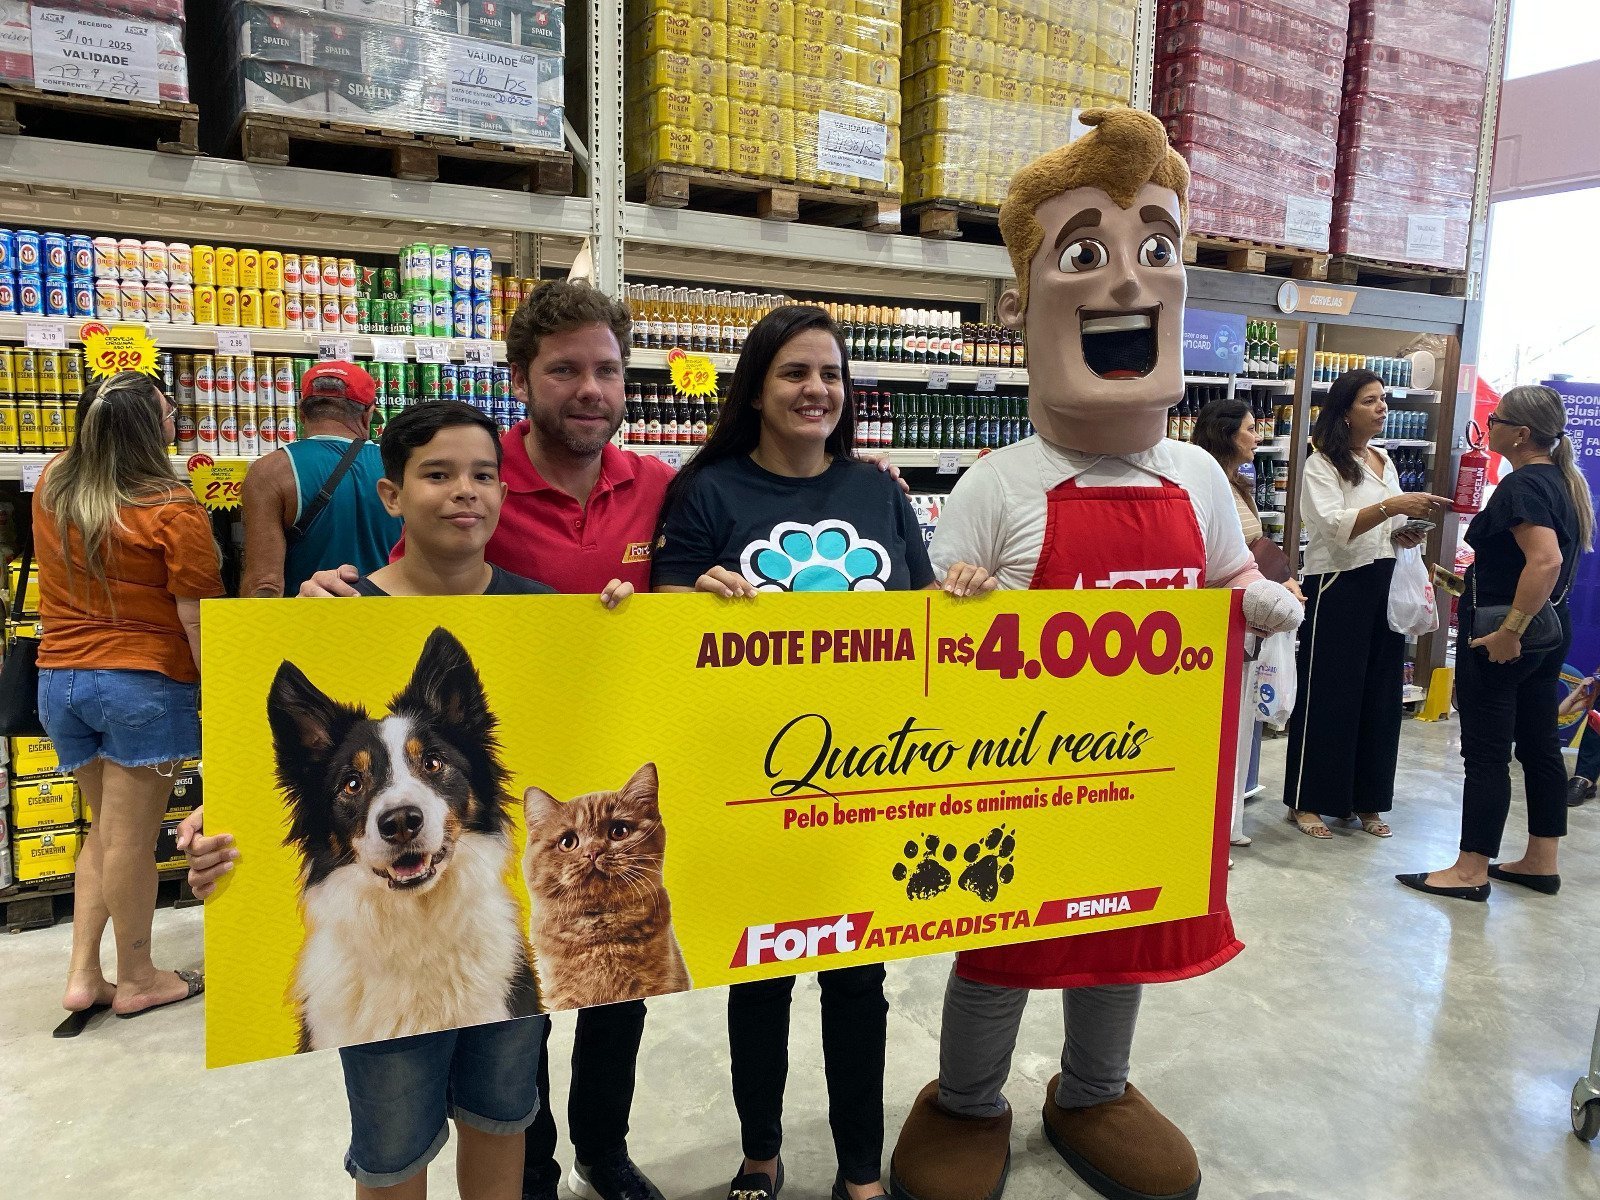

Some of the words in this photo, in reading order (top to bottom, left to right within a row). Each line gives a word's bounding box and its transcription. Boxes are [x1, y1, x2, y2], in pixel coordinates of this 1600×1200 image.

[737, 3, 756, 13] PILSEN
[804, 7, 825, 19] SKOL
[1205, 0, 1230, 15] BRAHMA
[77, 19, 113, 29] RECEBIDO
[479, 17, 502, 28] SPATEN
[667, 15, 690, 28] SKOL
[804, 17, 822, 26] PILSEN
[531, 27, 553, 38] SPATEN
[667, 27, 687, 36] PILSEN
[737, 29, 759, 41] SKOL
[108, 39, 133, 51] 2025
[263, 35, 290, 47] SPATEN
[737, 39, 756, 48] PILSEN
[325, 45, 350, 56] SPATEN
[803, 43, 824, 54] SKOL
[62, 48, 129, 67] VALIDADE
[467, 49, 518, 68] VALIDADE
[667, 53, 690, 66] SKOL
[264, 71, 311, 90] SPATEN
[738, 69, 759, 80] SKOL
[347, 82, 392, 100] SPATEN
[668, 92, 692, 104] SKOL
[668, 103, 689, 112] PILSEN
[738, 106, 760, 118] SKOL
[480, 121, 503, 132] SPATEN
[738, 116, 758, 125] PILSEN
[670, 132, 693, 143] SKOL
[670, 142, 690, 151] PILSEN
[739, 143, 761, 154] SKOL
[1309, 293, 1344, 308] CERVEJAS
[1471, 467, 1485, 507] MOCELIN
[631, 544, 650, 557] Fort
[696, 630, 805, 668] ADOTE
[812, 628, 916, 664] PENHA
[28, 743, 55, 753] EISENB
[763, 713, 966, 799] Quatro
[967, 710, 1049, 771] mil
[1047, 720, 1155, 766] reais
[28, 794, 63, 806] EISENBAHN
[783, 804, 829, 830] Pelo
[833, 802, 937, 826] bem-estar
[940, 796, 972, 817] dos
[976, 787, 1048, 812] animais
[1051, 787, 1073, 806] de
[1076, 784, 1136, 804] Penha.
[31, 845, 66, 858] EISENBAHN
[745, 913, 861, 966] Fort
[865, 910, 1032, 949] ATACADISTA
[1065, 895, 1131, 919] PENHA
